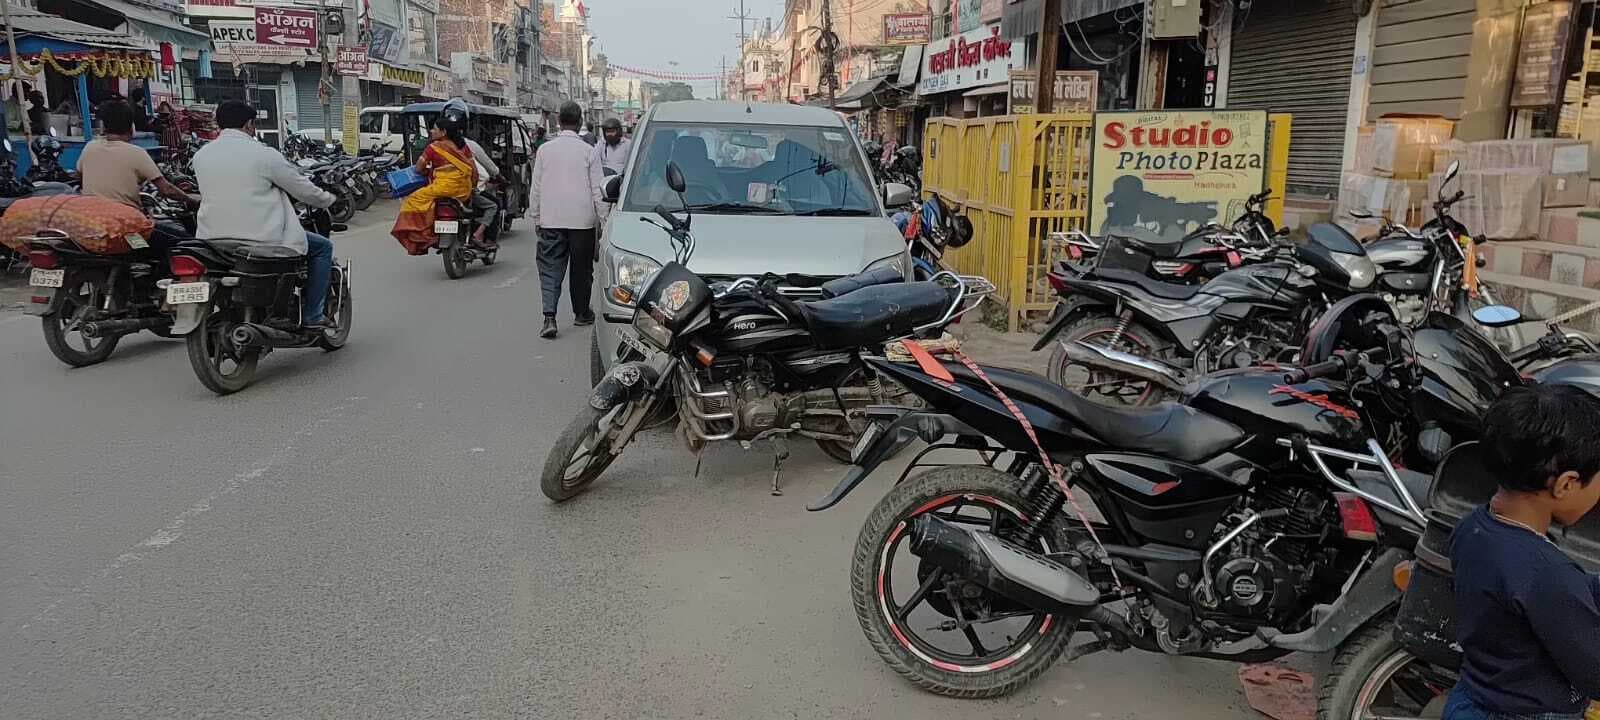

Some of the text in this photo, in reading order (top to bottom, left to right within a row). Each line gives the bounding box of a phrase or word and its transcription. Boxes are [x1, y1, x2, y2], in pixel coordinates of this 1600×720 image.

[213, 27, 246, 41] APEX
[1103, 120, 1234, 150] Studio
[1115, 151, 1263, 171] Photo Plaza
[733, 321, 756, 331] Hero
